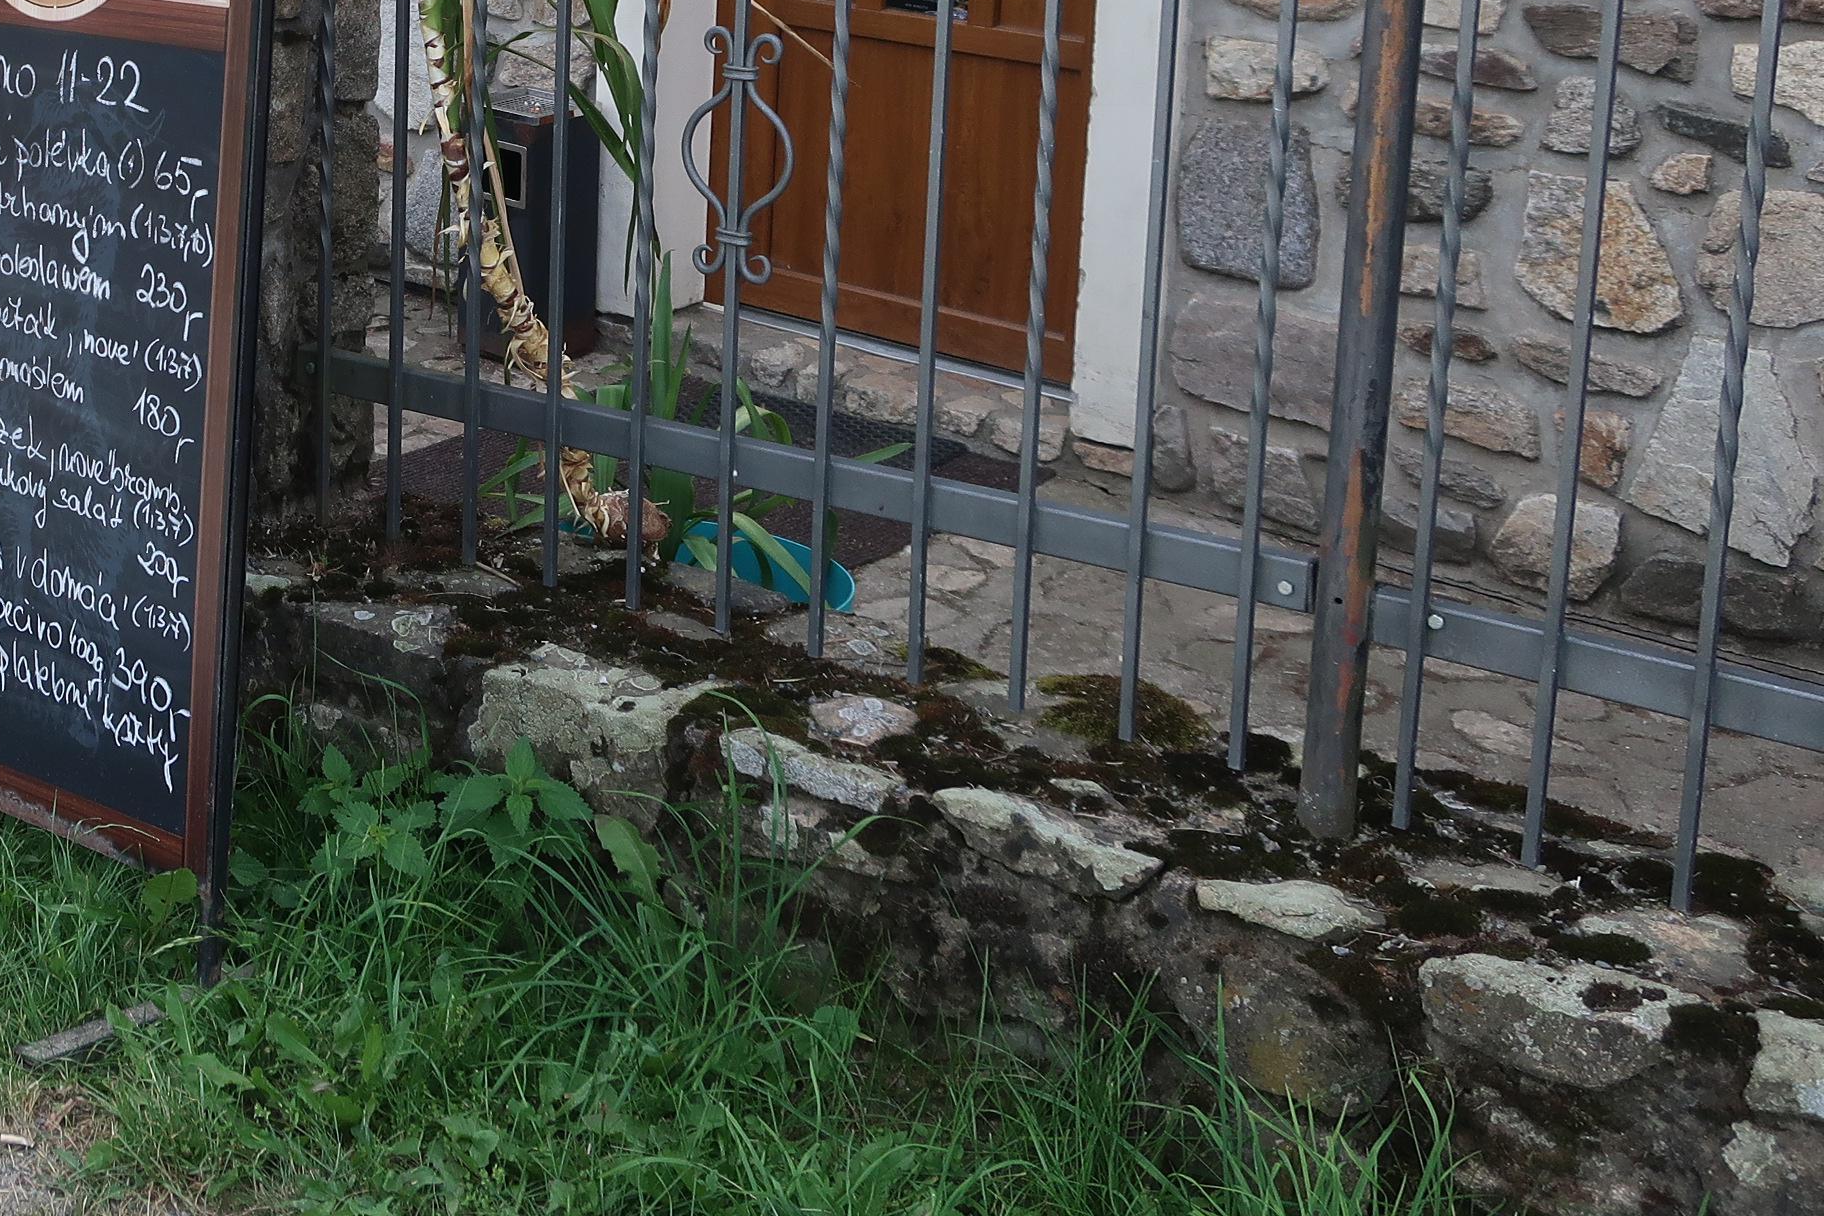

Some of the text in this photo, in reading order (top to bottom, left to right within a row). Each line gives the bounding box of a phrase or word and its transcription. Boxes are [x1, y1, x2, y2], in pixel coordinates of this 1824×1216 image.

[56, 48, 150, 113] 11-22
[12, 127, 112, 184] polévka
[51, 485, 124, 529] salát
[30, 547, 129, 631] domácí
